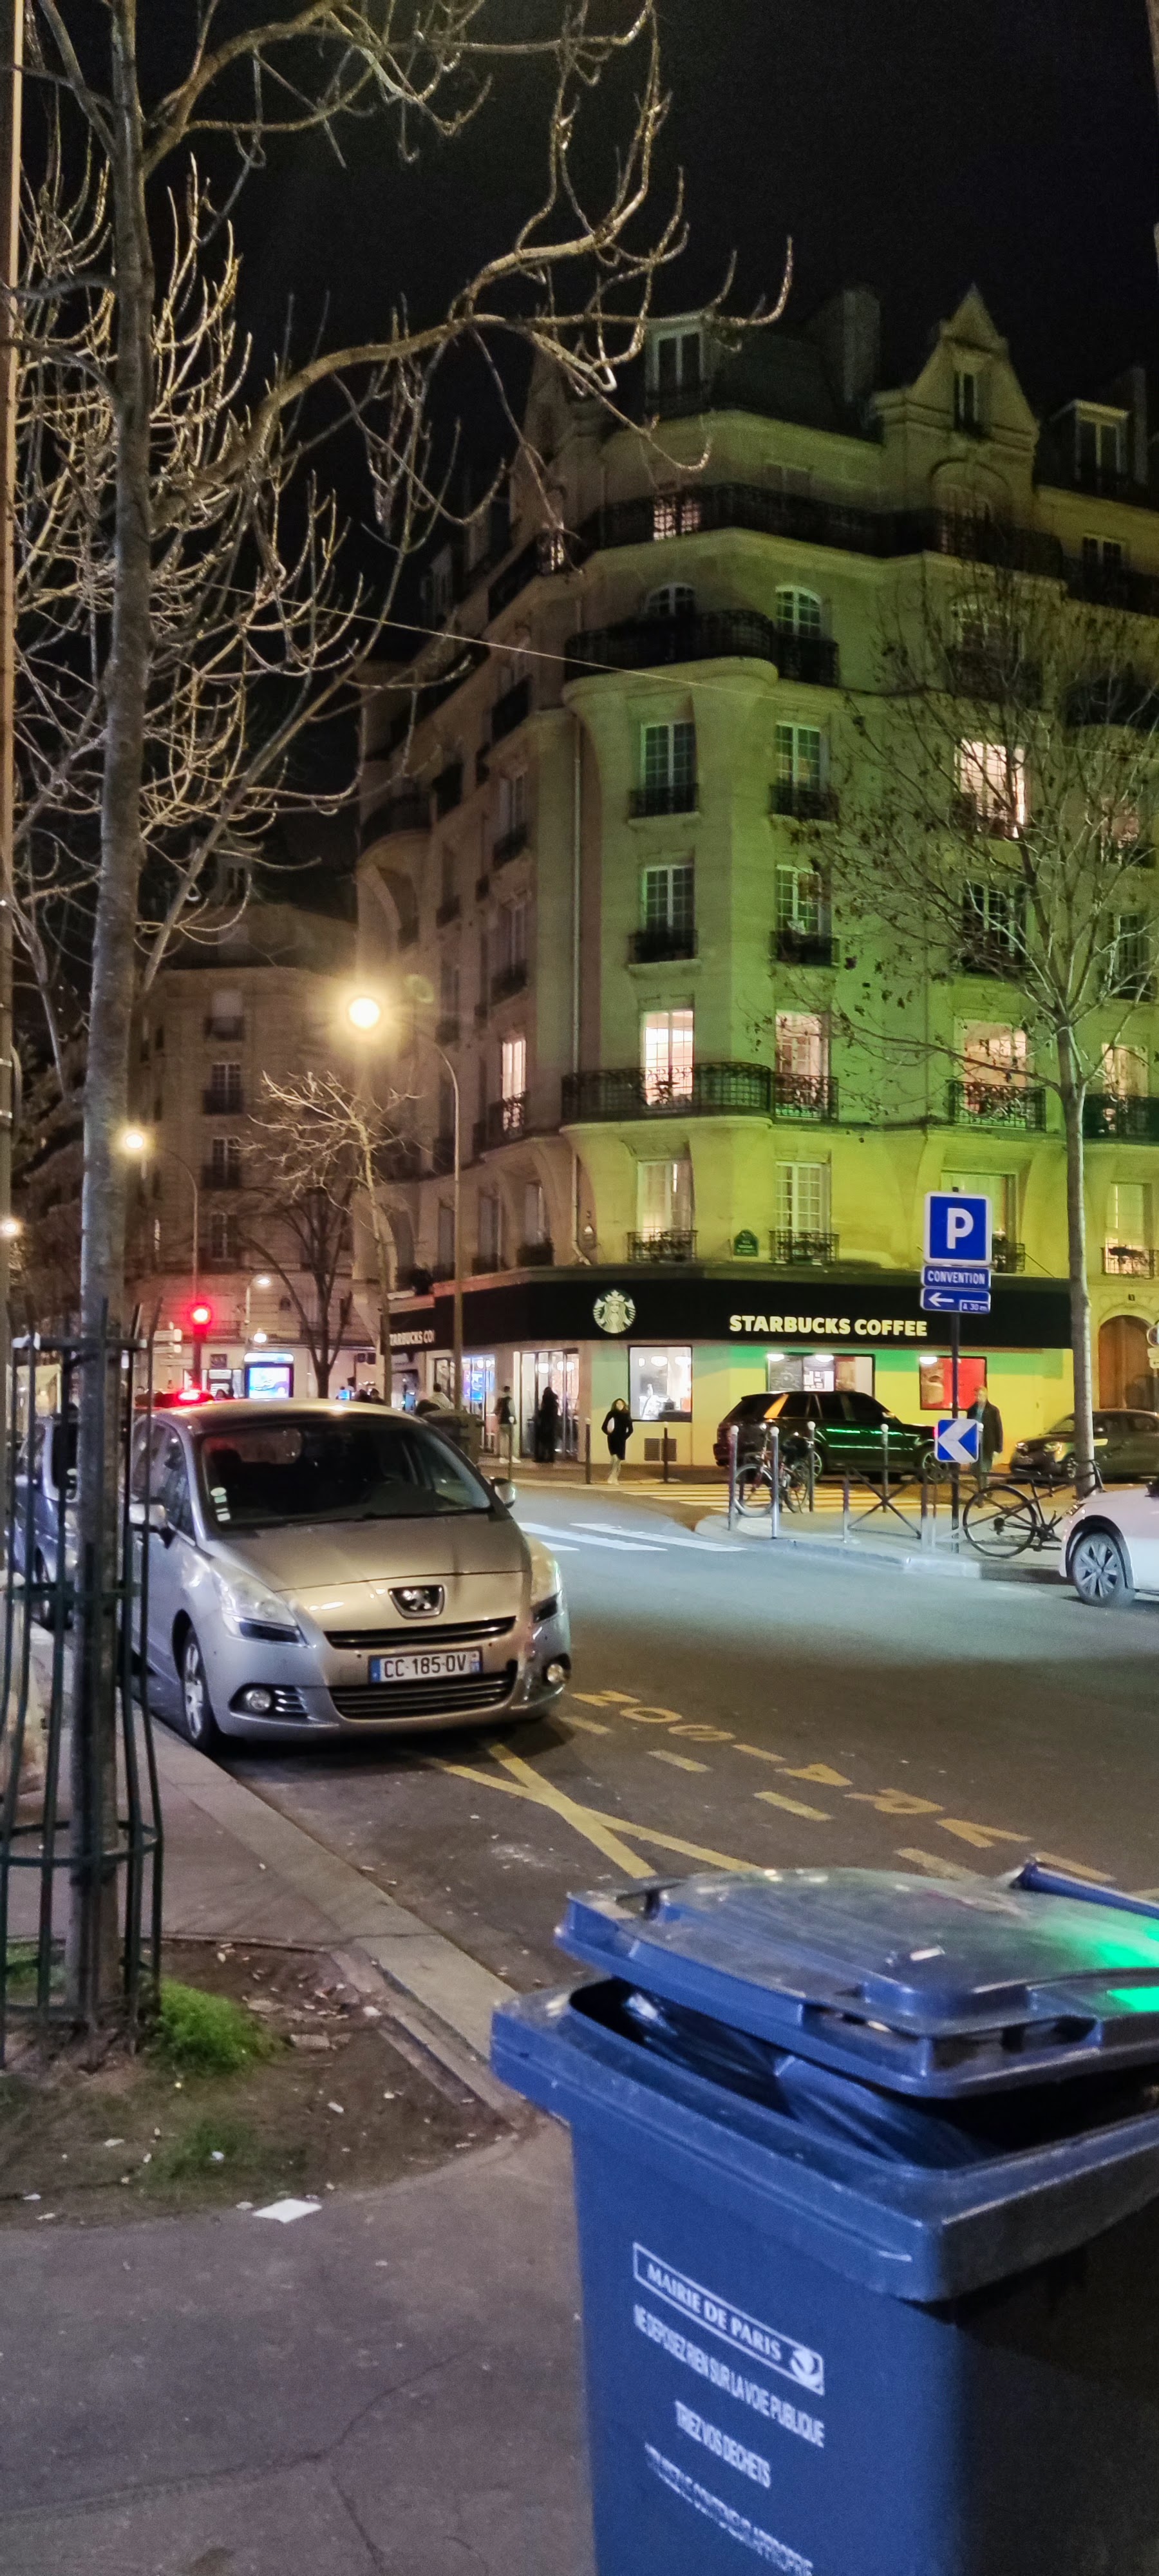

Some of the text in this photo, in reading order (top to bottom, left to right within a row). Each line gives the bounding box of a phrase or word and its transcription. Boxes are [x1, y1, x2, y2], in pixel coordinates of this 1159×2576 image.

[947, 1208, 974, 1249] P
[927, 1270, 986, 1285] CONVENTION
[970, 1303, 979, 1311] 30
[729, 1314, 928, 1337] STARBUCKS COFFEE
[647, 2262, 782, 2362] MAIRIE DE PARIS
[709, 2356, 731, 2393] SUR
[730, 2371, 746, 2401] LA
[744, 2378, 771, 2418] VOIE
[769, 2394, 825, 2448] PUBLIQUE
[702, 2422, 722, 2457] VOS
